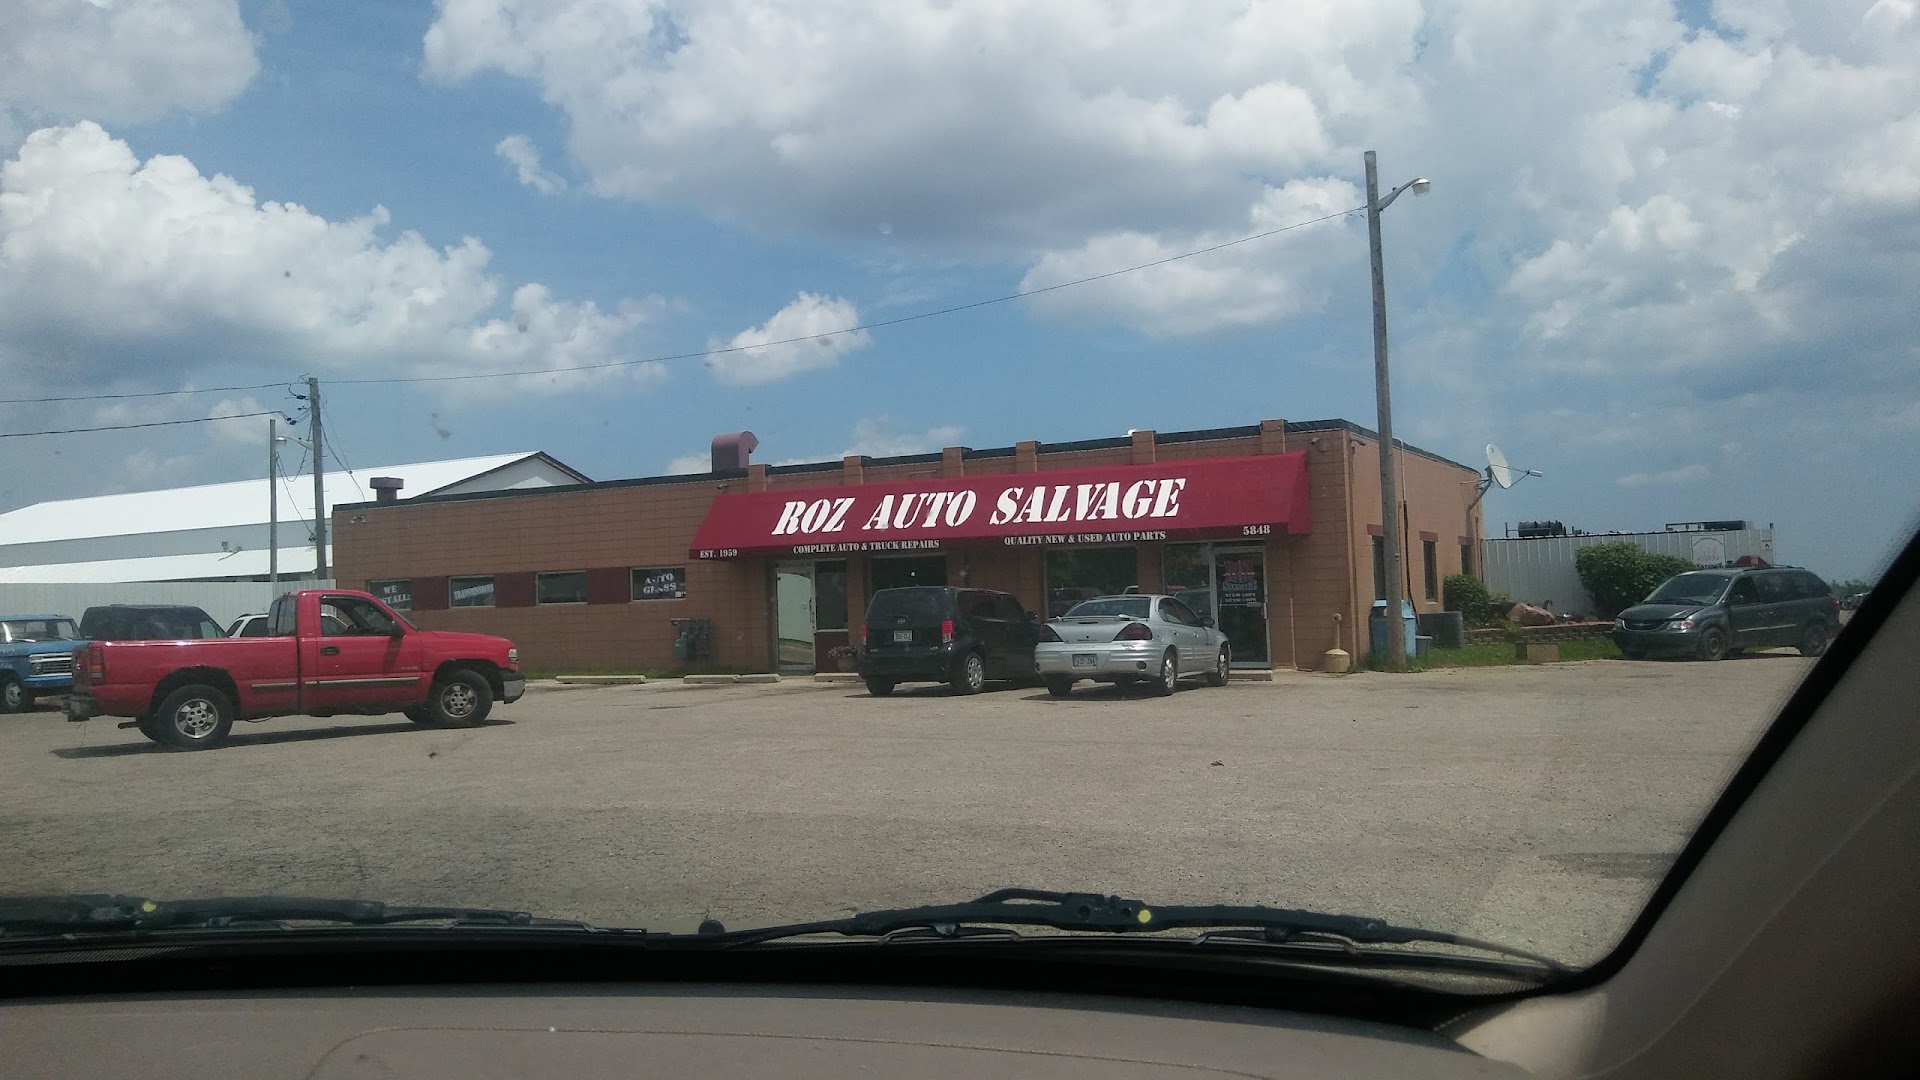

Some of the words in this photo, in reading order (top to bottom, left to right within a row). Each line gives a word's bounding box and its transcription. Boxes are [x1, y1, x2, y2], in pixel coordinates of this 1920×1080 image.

[771, 497, 856, 536] ROZ
[862, 489, 978, 532] AUTO
[989, 477, 1187, 526] SALVAGE
[1242, 524, 1271, 536] 5848
[1004, 535, 1044, 546] QUALITY
[1045, 534, 1065, 544] NEW
[1068, 534, 1075, 543] &
[1077, 533, 1103, 543] USED
[1105, 532, 1131, 542] AUTO
[1133, 530, 1167, 541] PARTS
[793, 543, 836, 554] COMPLETE
[837, 542, 860, 552] AUTO
[861, 543, 868, 551] &
[869, 541, 899, 551] TRUCK
[901, 539, 940, 549] REPAIRS
[700, 550, 717, 558] EST.
[719, 548, 738, 558] 1959
[645, 573, 675, 585] AUTO
[383, 585, 398, 594] WE
[643, 582, 677, 595] GLASS
